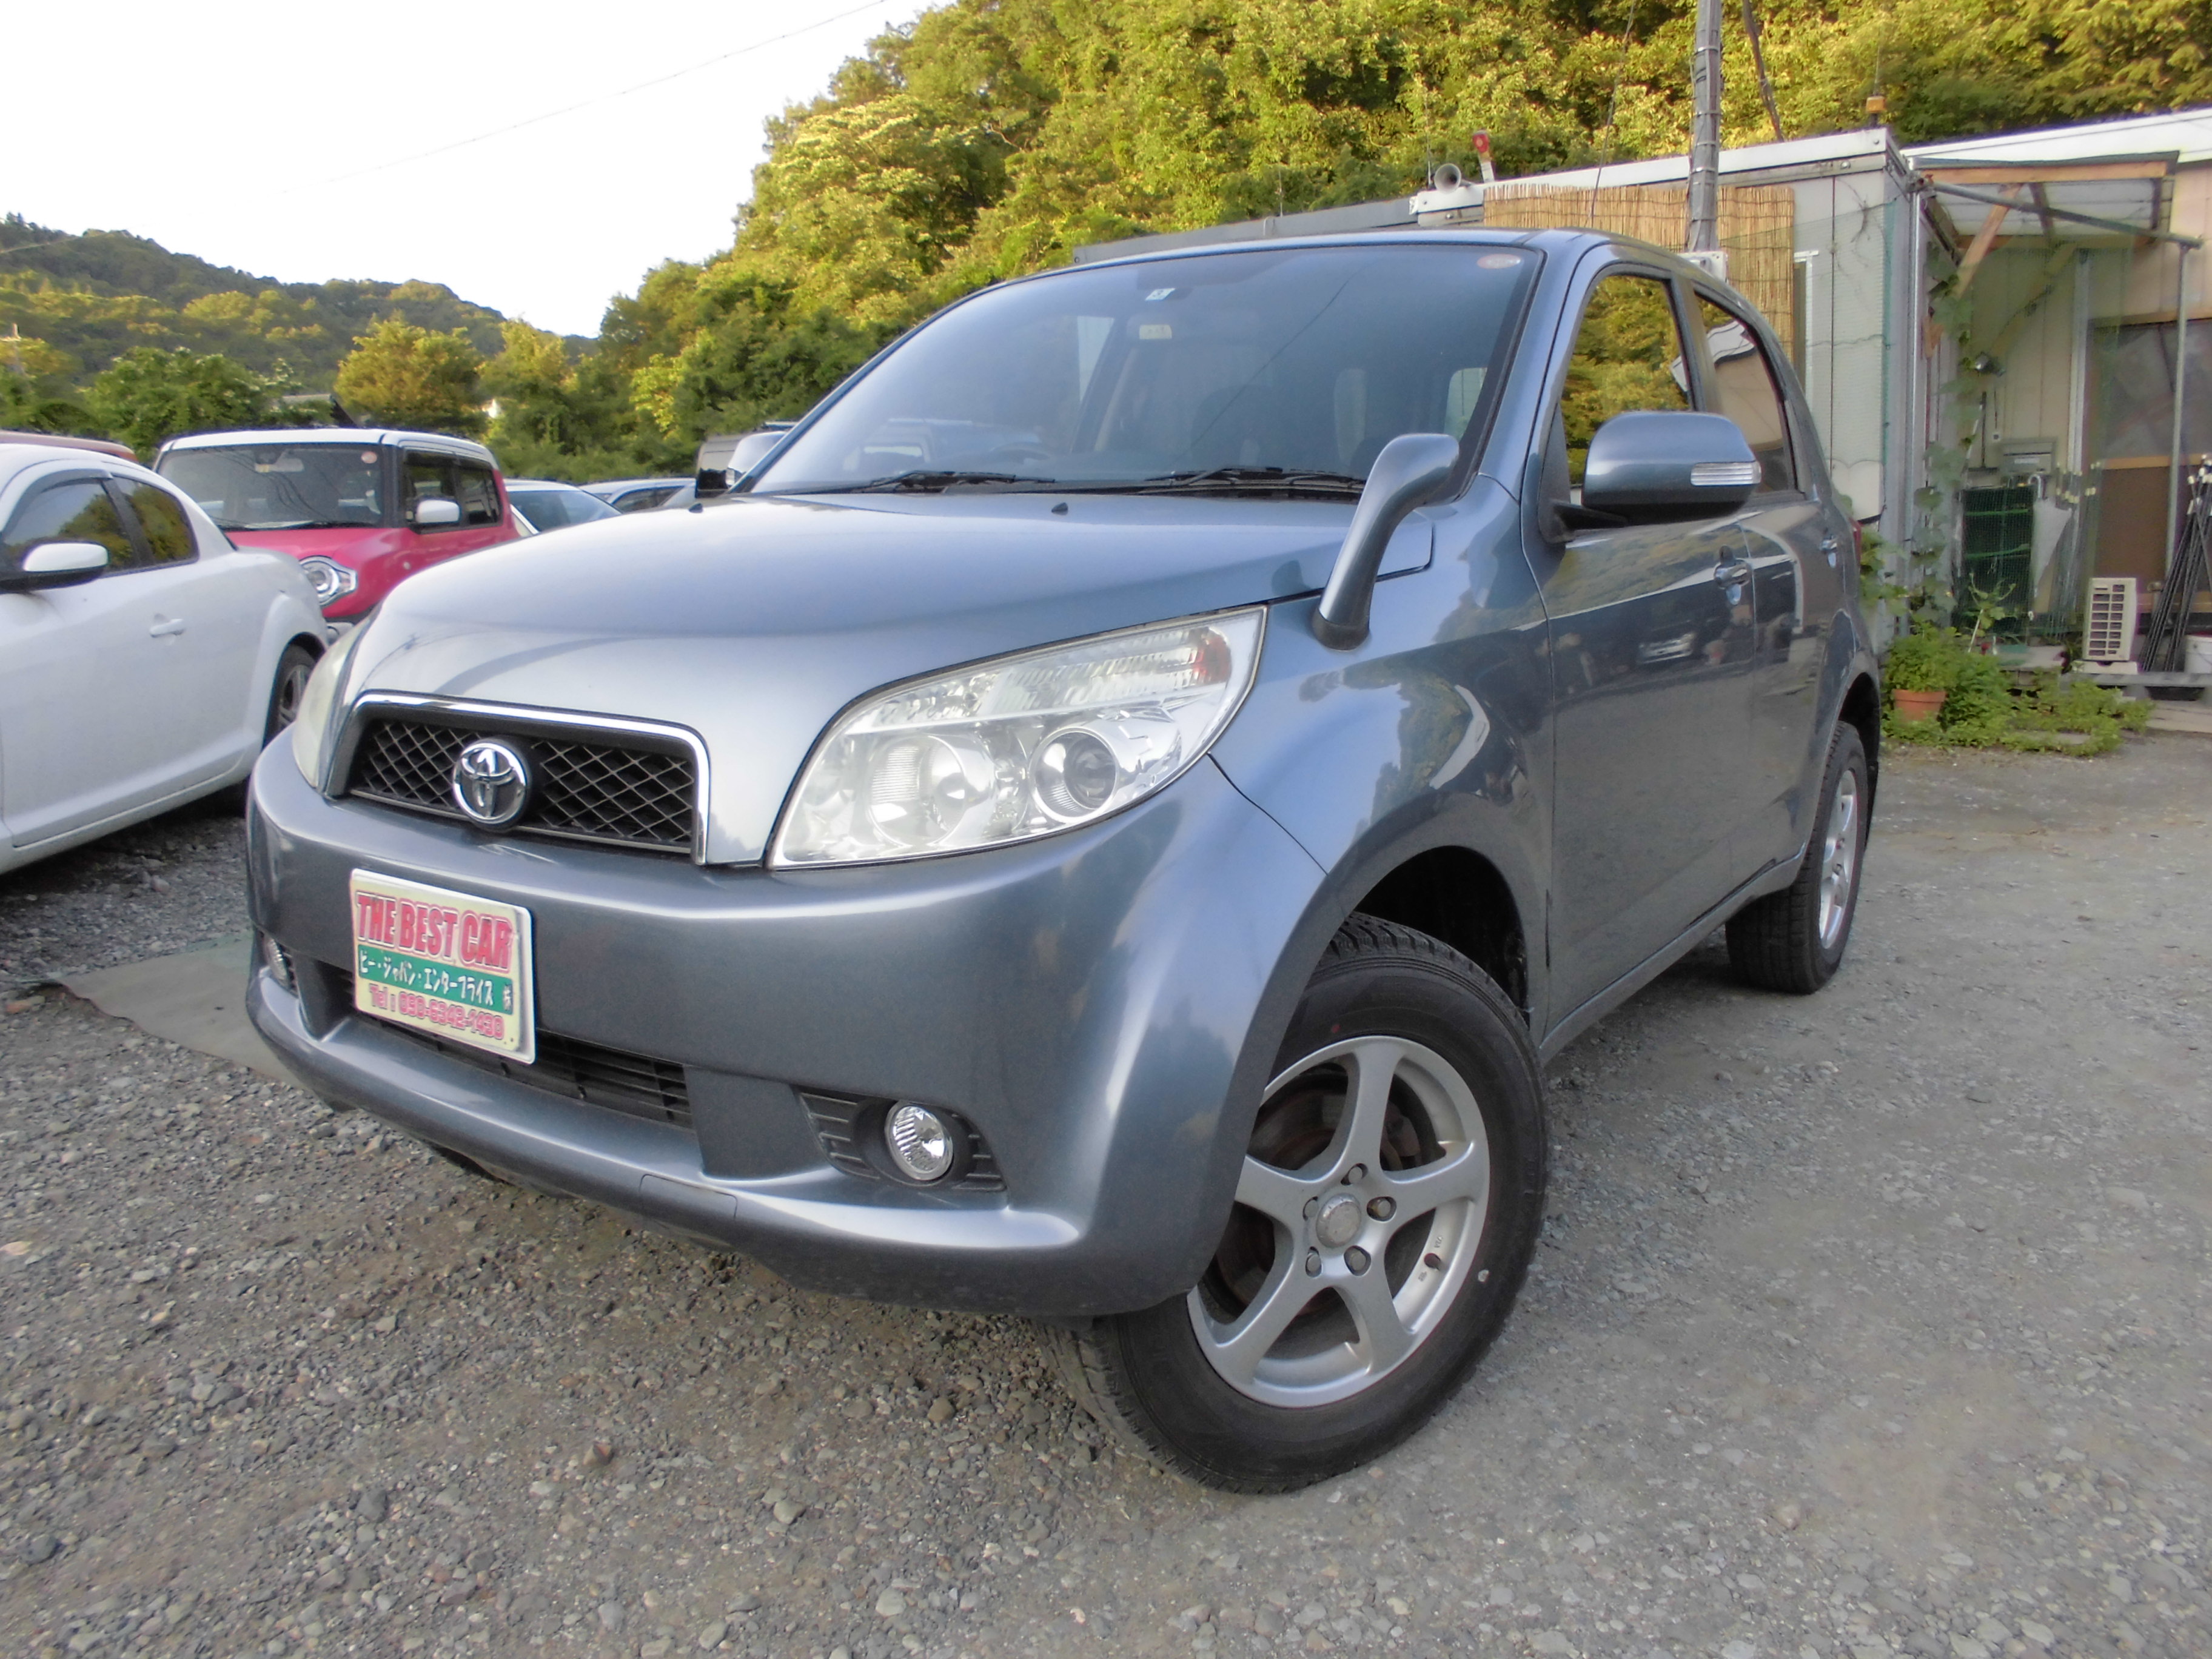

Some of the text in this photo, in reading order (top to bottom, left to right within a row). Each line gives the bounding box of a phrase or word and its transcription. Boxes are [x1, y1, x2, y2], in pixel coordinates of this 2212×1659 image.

[357, 891, 512, 971] THE BEST CAR
